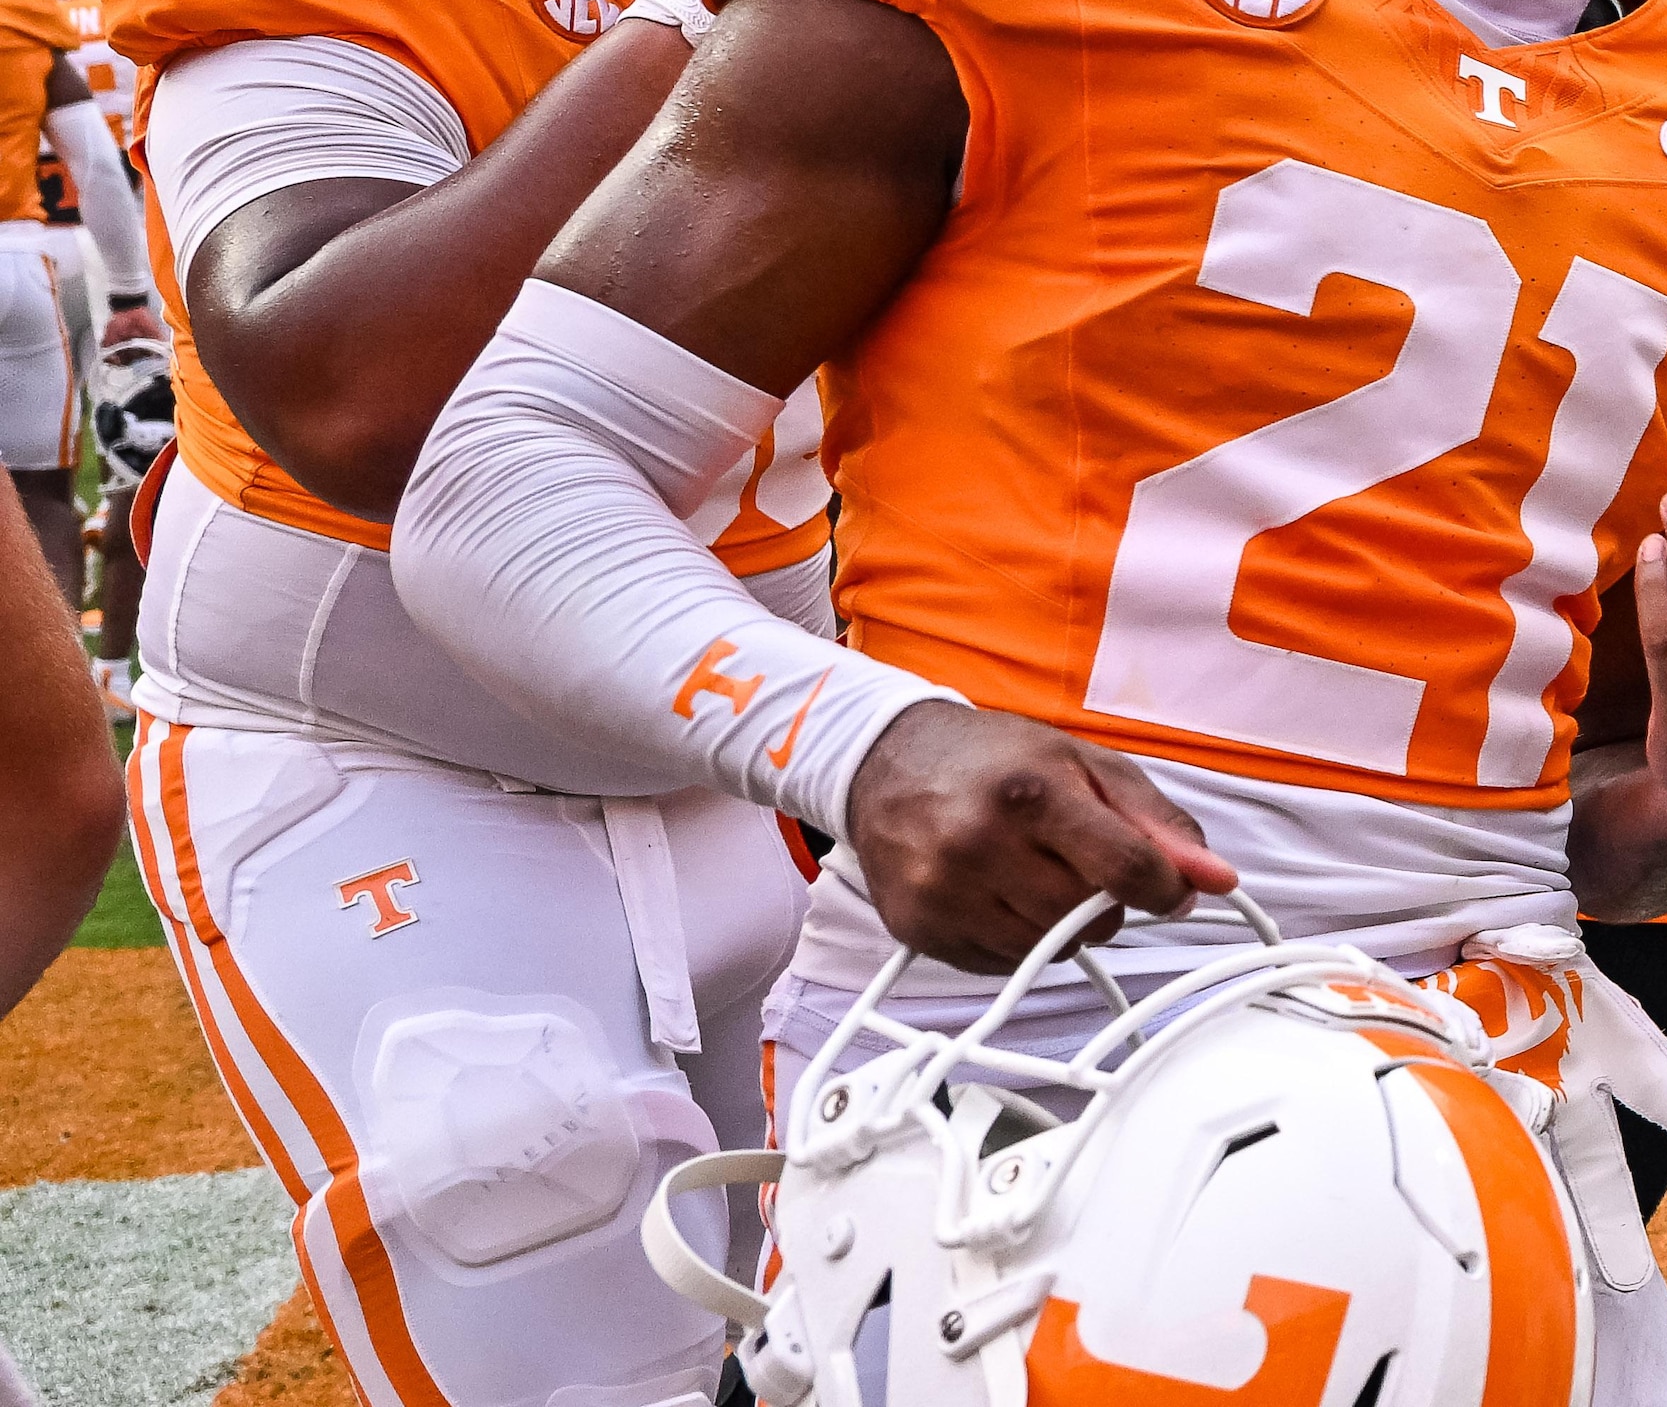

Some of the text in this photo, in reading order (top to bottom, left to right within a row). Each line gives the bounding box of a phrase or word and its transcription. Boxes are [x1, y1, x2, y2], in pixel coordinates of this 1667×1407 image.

[1456, 53, 1528, 130] T
[672, 639, 766, 721] T
[334, 857, 421, 939] T
